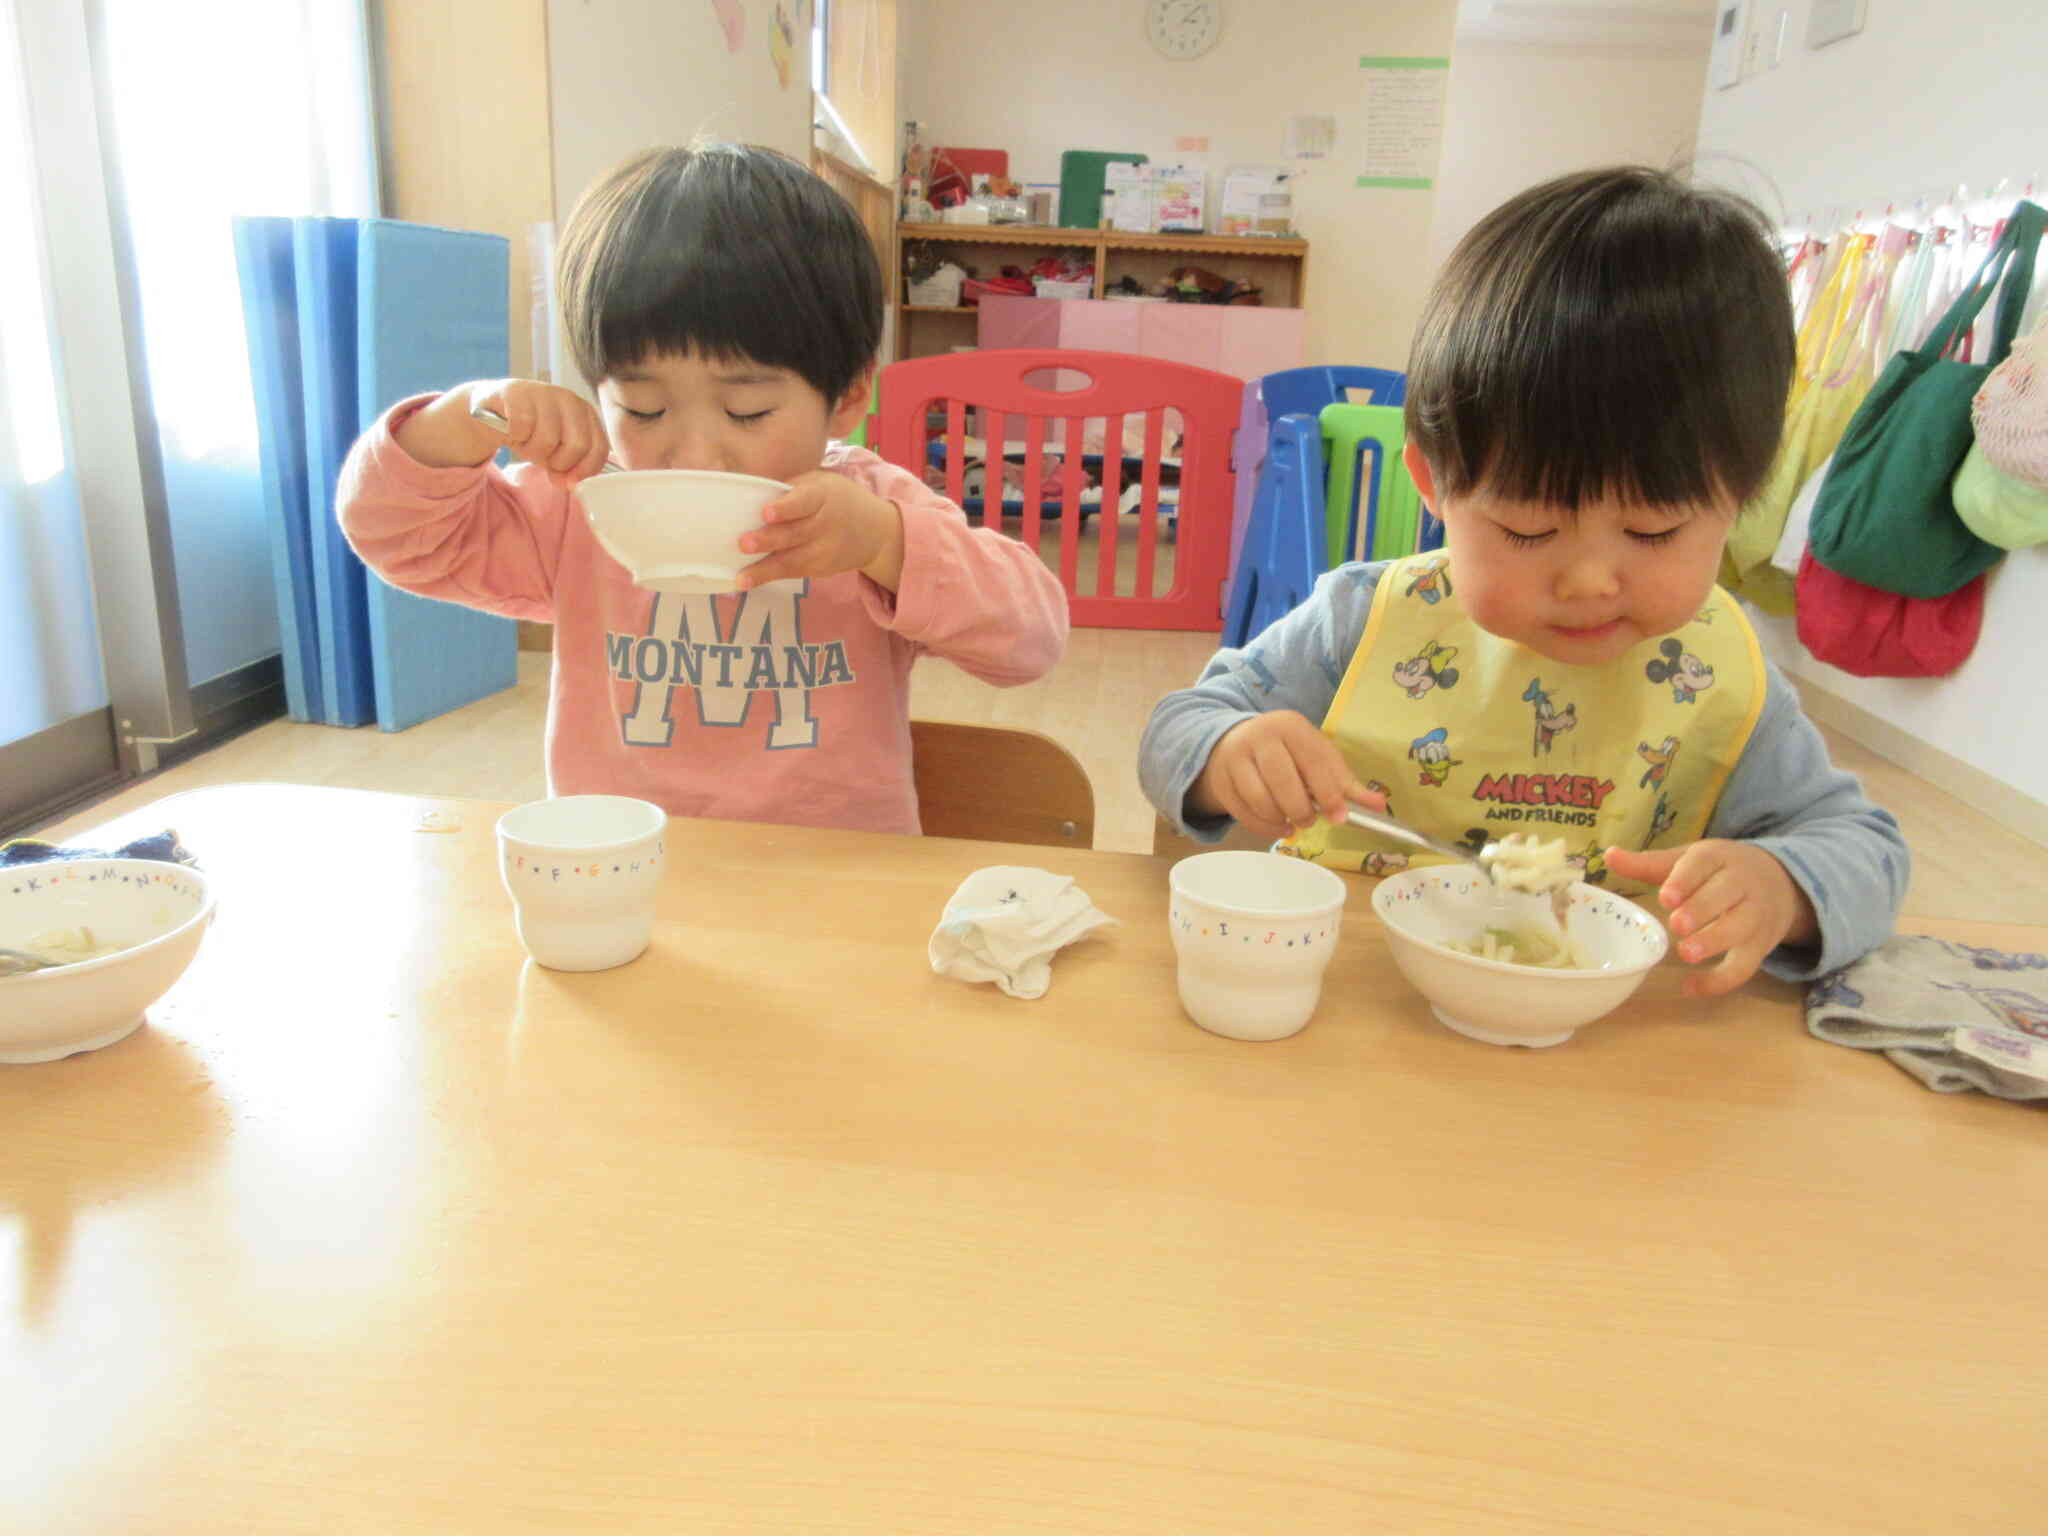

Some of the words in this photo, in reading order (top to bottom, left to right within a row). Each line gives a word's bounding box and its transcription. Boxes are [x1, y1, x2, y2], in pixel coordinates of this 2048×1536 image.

[606, 632, 856, 690] MONTANA
[622, 576, 819, 751] M
[1472, 773, 1616, 810] MICKEY
[1486, 807, 1522, 821] AND
[1525, 808, 1597, 827] FRIENDS
